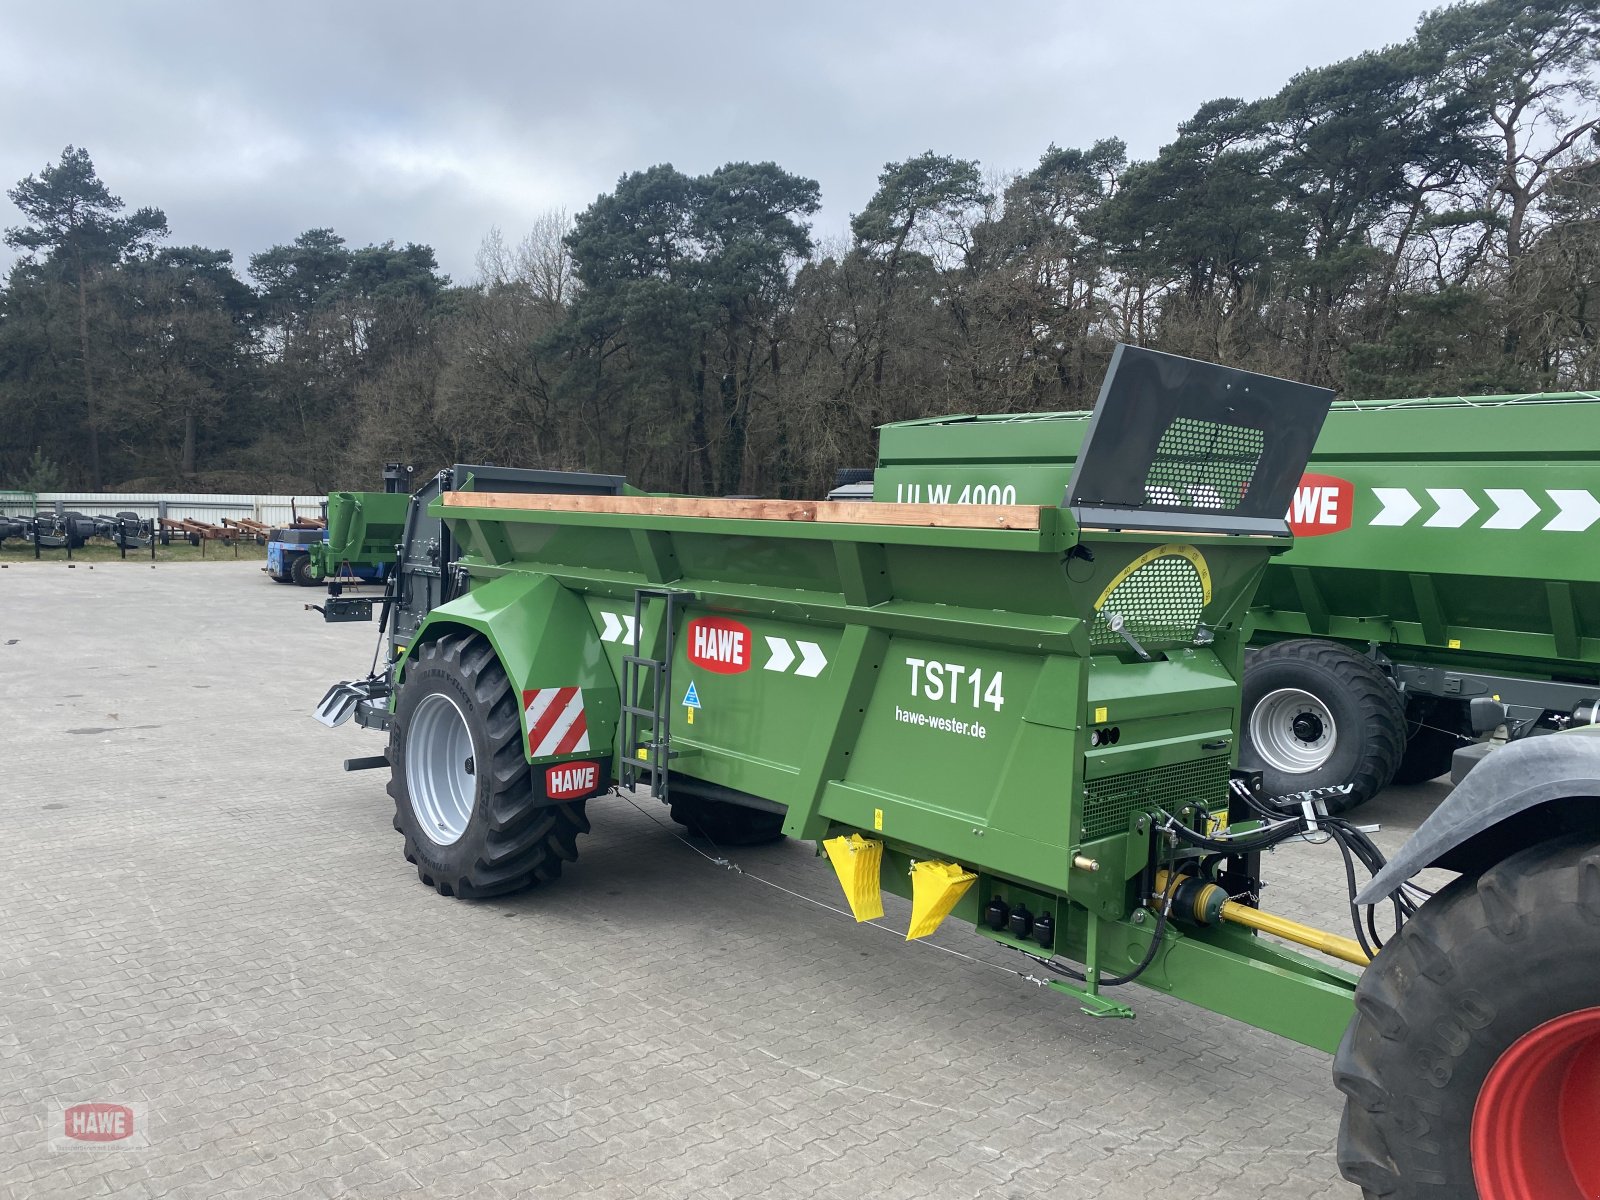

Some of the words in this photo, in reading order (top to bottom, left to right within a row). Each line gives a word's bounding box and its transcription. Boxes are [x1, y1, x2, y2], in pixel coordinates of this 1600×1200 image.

[957, 484, 1016, 505] 4000
[1284, 487, 1339, 524] WE
[694, 625, 744, 665] HAWE
[895, 705, 987, 739] hawe-wester.de
[551, 767, 595, 794] HAWE
[1410, 987, 1498, 1090] 800
